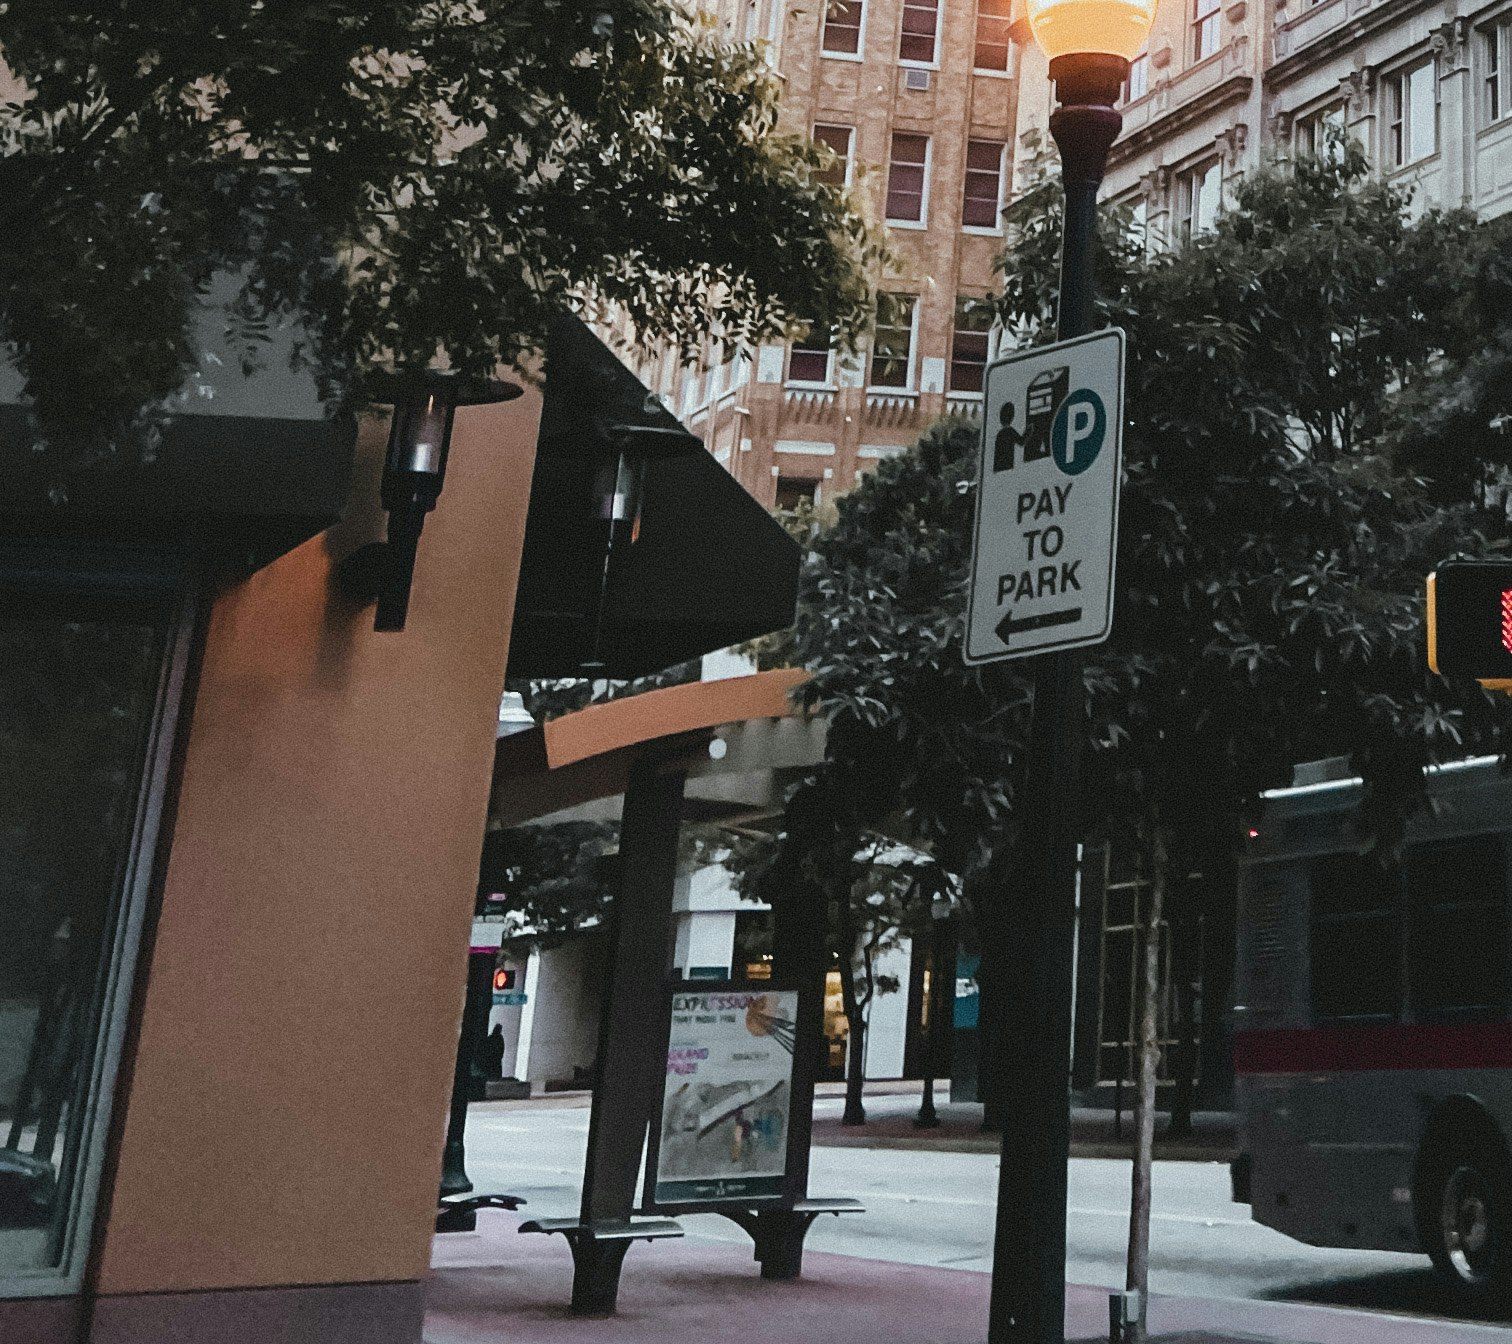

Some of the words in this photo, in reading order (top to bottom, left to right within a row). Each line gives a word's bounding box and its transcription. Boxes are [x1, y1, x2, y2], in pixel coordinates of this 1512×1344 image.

[1065, 401, 1097, 463] P
[1016, 482, 1073, 525] PAY
[1022, 524, 1064, 561] TO
[996, 559, 1082, 606] PARK
